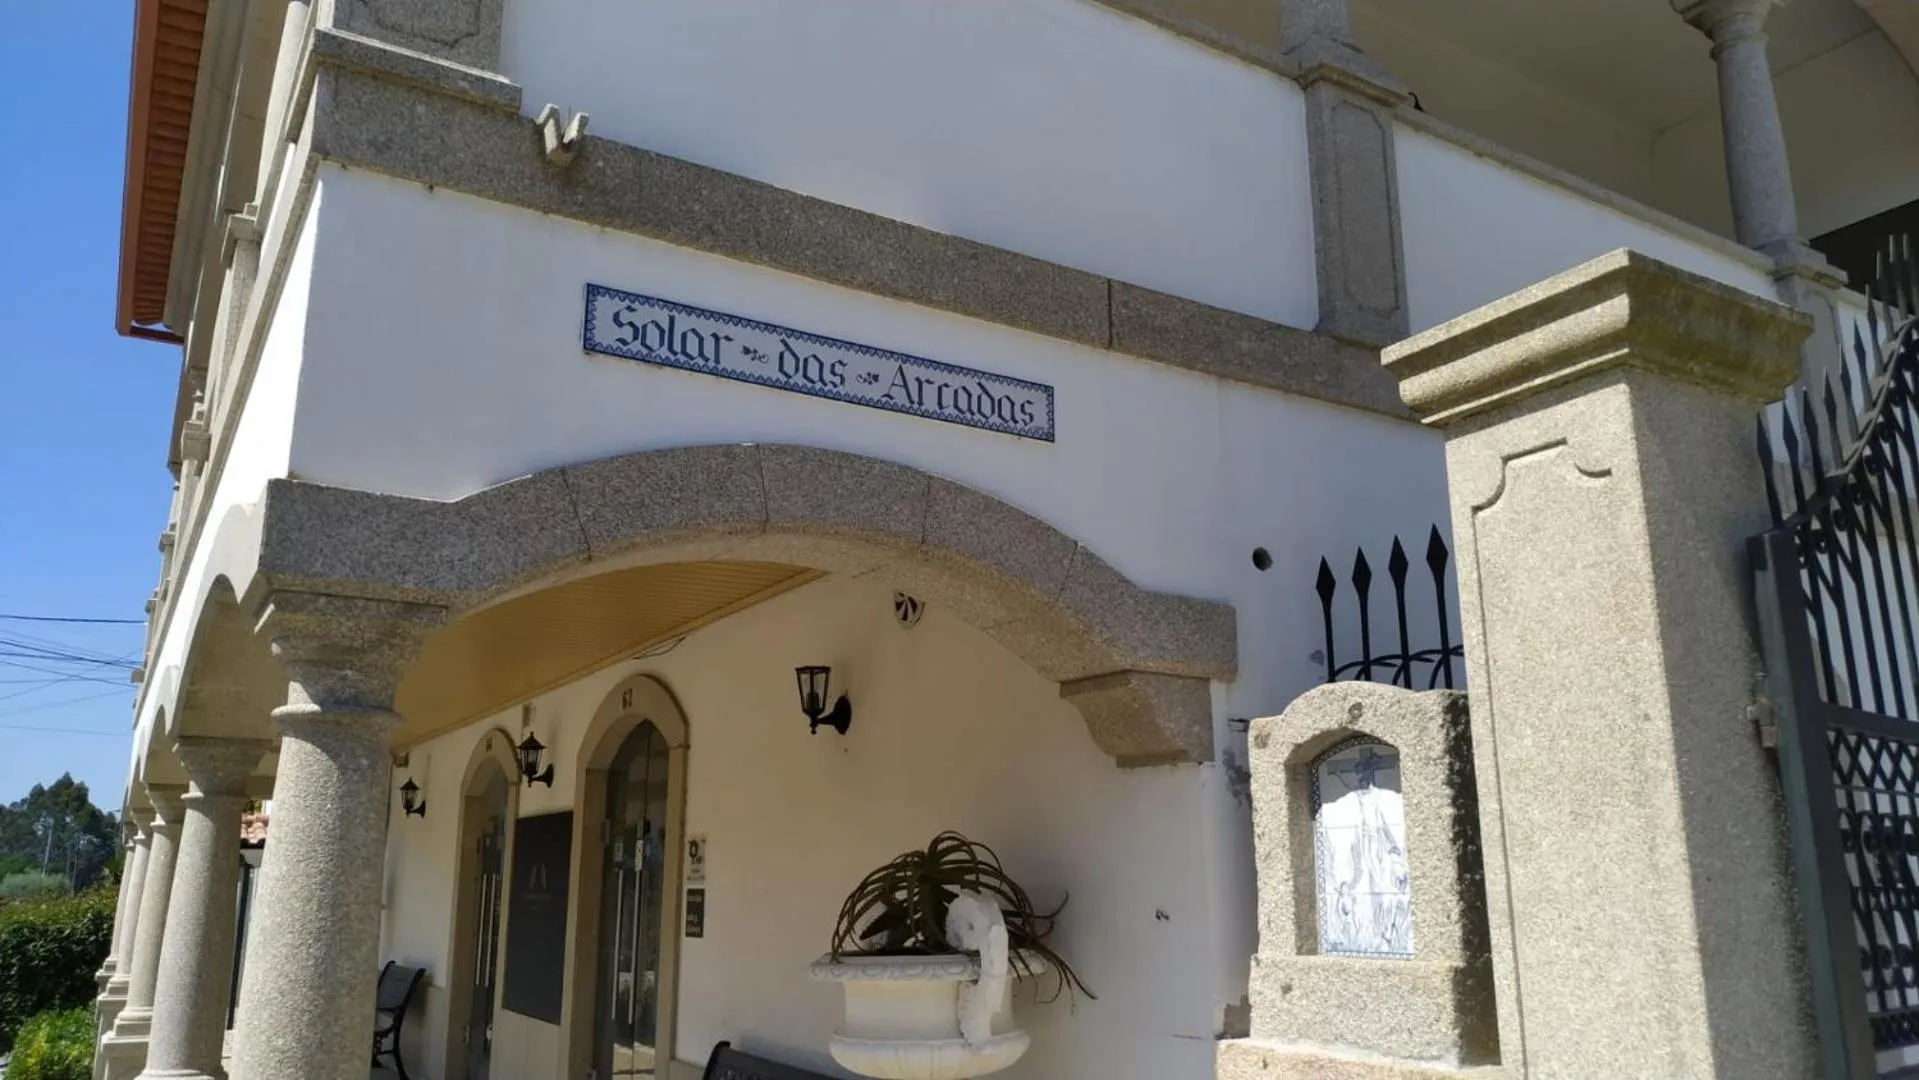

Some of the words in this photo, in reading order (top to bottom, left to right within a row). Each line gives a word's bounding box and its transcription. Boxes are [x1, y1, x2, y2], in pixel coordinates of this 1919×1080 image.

[612, 304, 733, 365] Solar
[777, 338, 849, 389] das
[881, 365, 1035, 426] Arcadas
